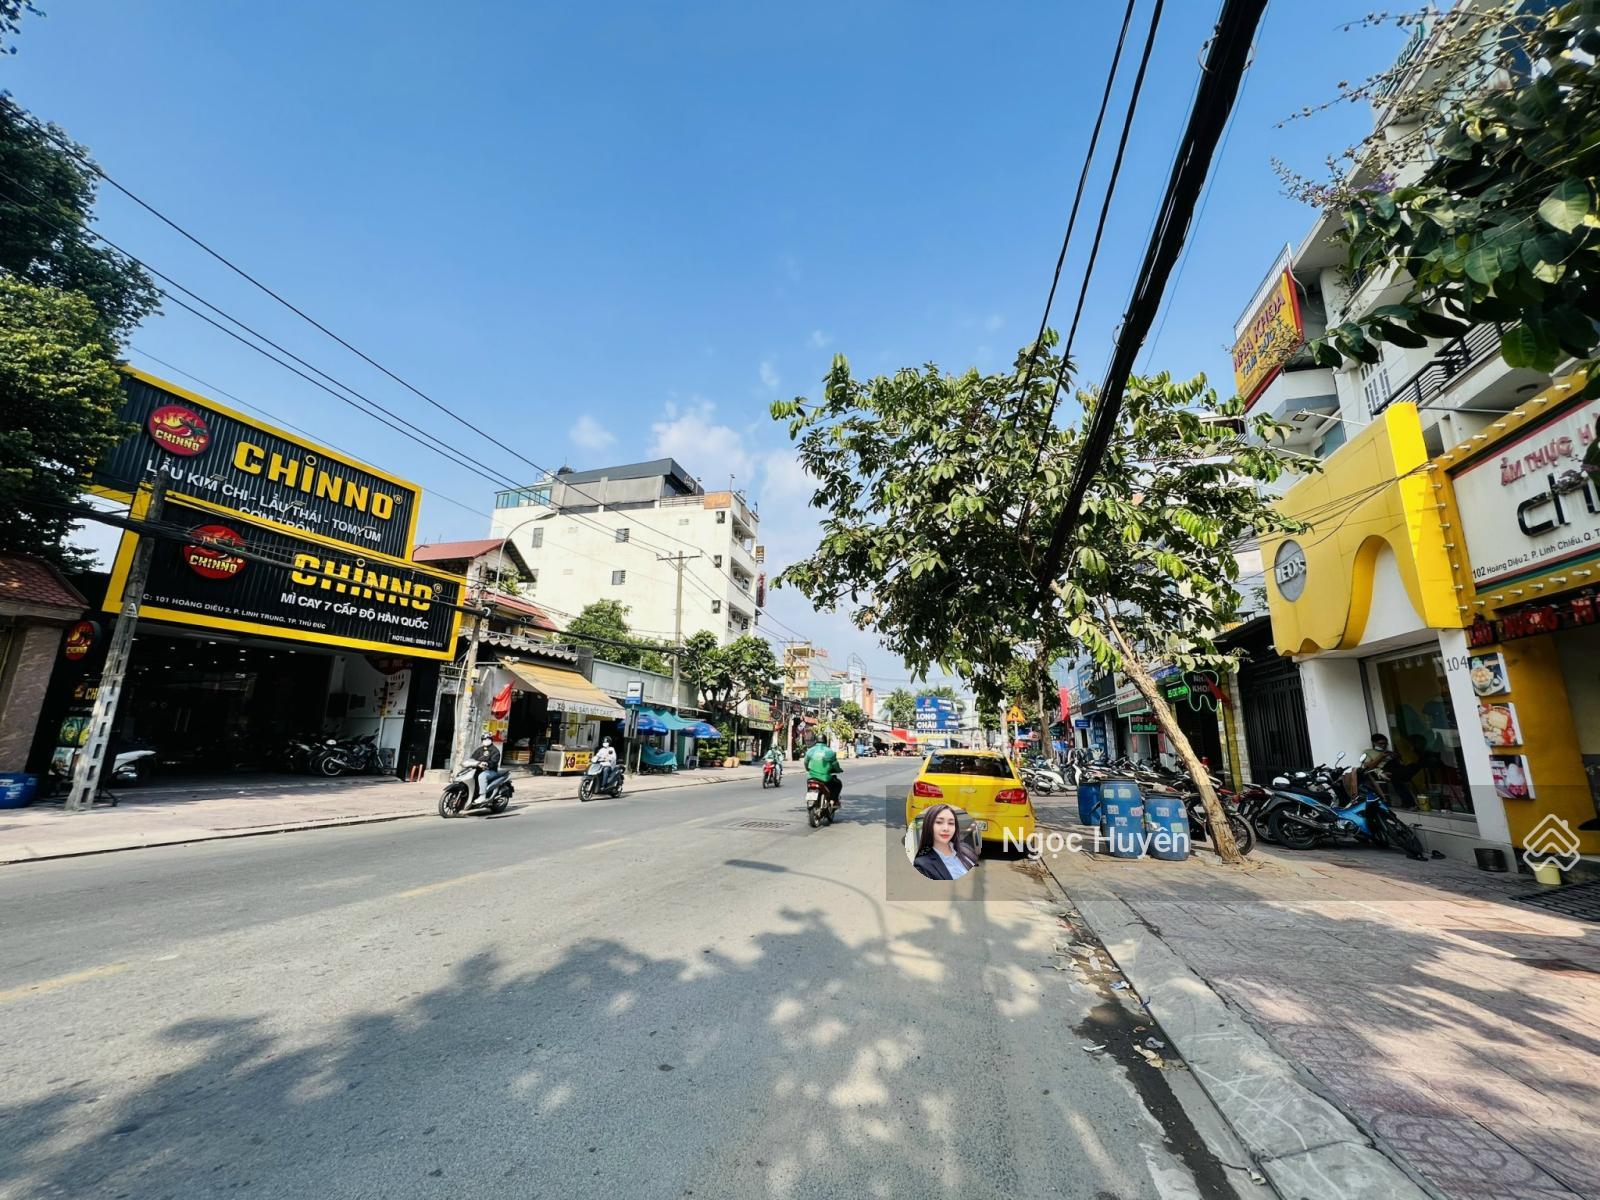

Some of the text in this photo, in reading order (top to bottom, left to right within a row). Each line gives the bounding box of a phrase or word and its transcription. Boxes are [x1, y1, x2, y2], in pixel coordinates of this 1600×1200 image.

[155, 429, 200, 452] CHINNO
[187, 472, 218, 492] KIM
[222, 484, 248, 501] CHI
[293, 505, 321, 524] THÁI
[190, 555, 237, 573] CHINNO
[1473, 566, 1486, 579] 102
[281, 592, 296, 605] MÌ
[298, 596, 322, 609] CAY
[324, 601, 332, 611] 7
[1446, 656, 1468, 672] 104
